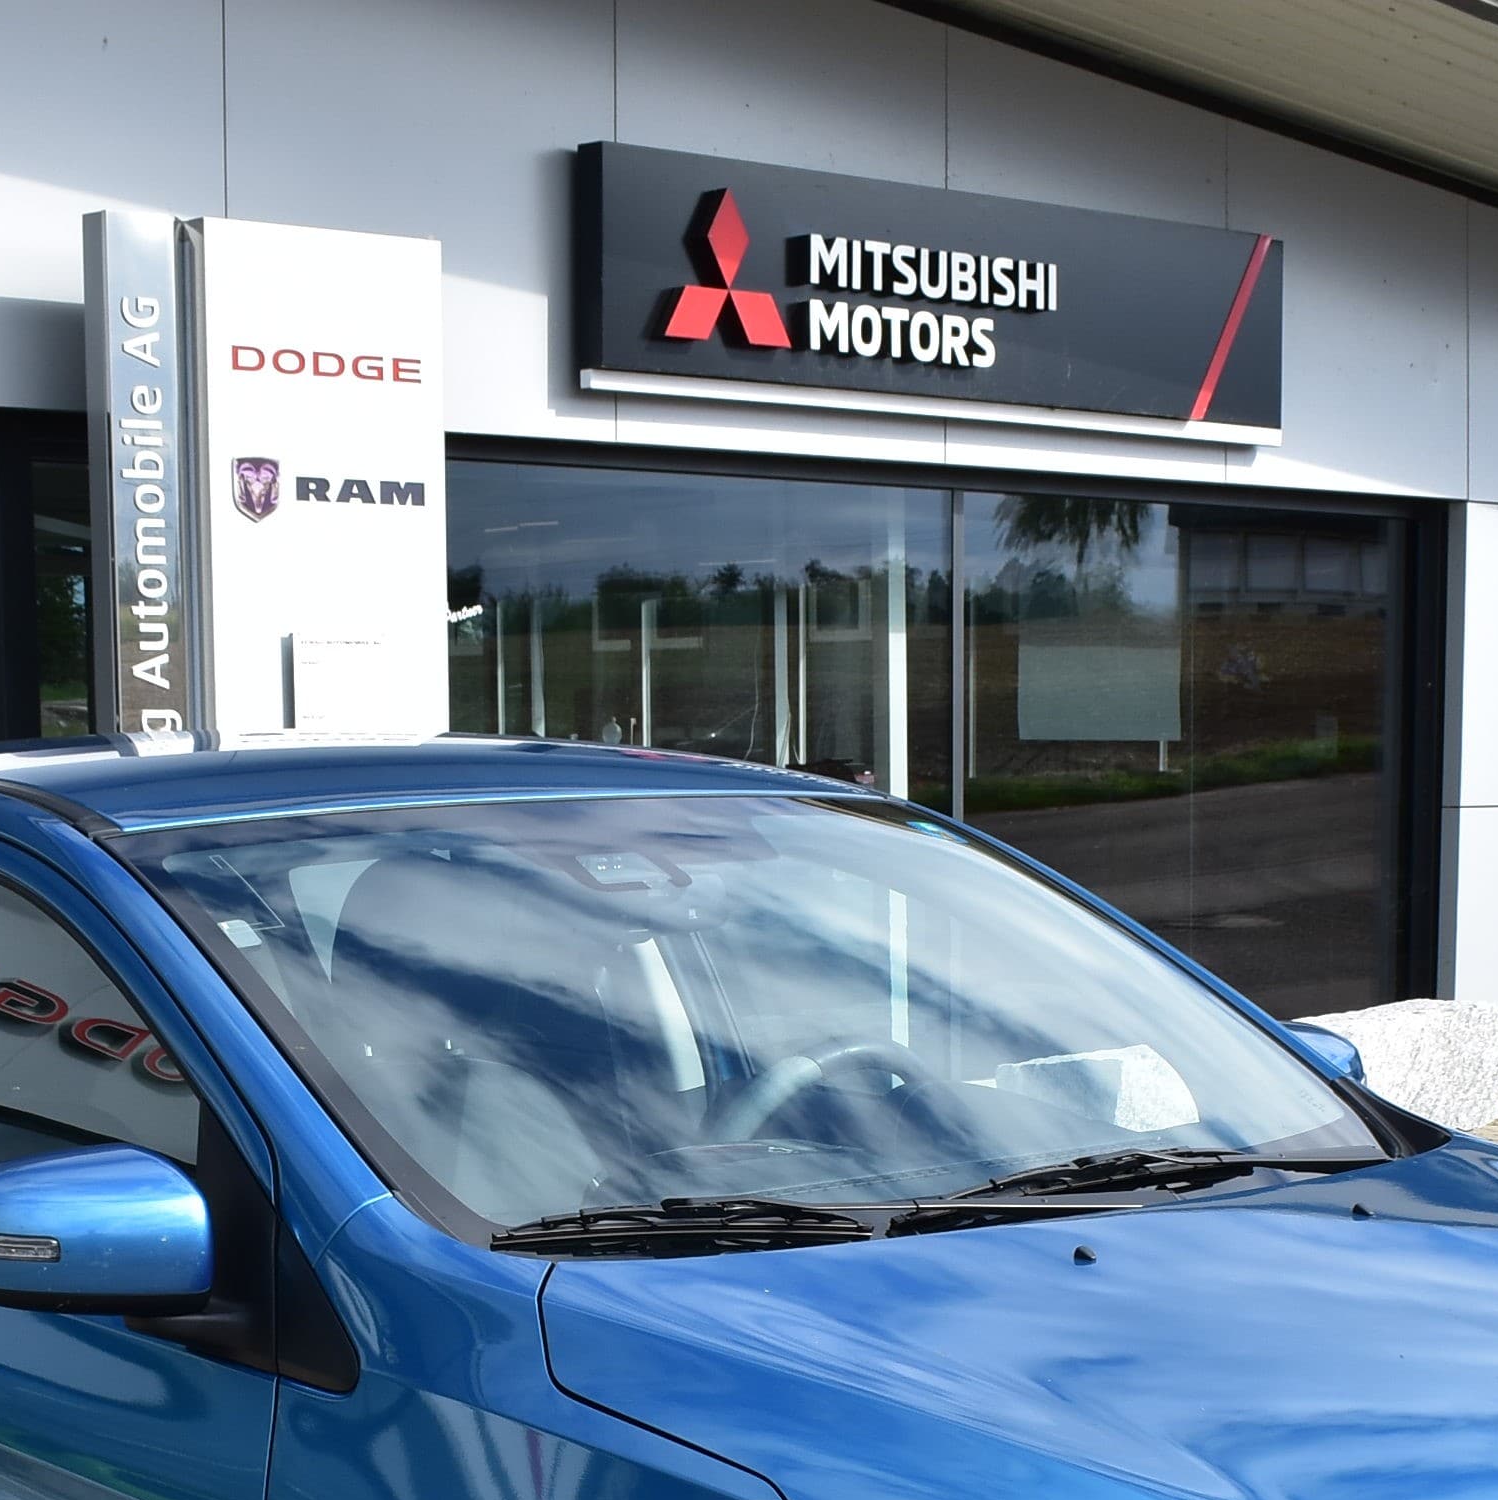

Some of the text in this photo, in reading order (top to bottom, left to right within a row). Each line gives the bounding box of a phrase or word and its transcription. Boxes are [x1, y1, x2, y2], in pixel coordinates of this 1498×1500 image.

[809, 232, 1058, 312] MITSUBISHI
[120, 296, 161, 368] AG
[231, 345, 422, 385] DODGE
[808, 298, 997, 369] MOTORS
[295, 476, 426, 507] RAM
[120, 384, 170, 690] Automobile
